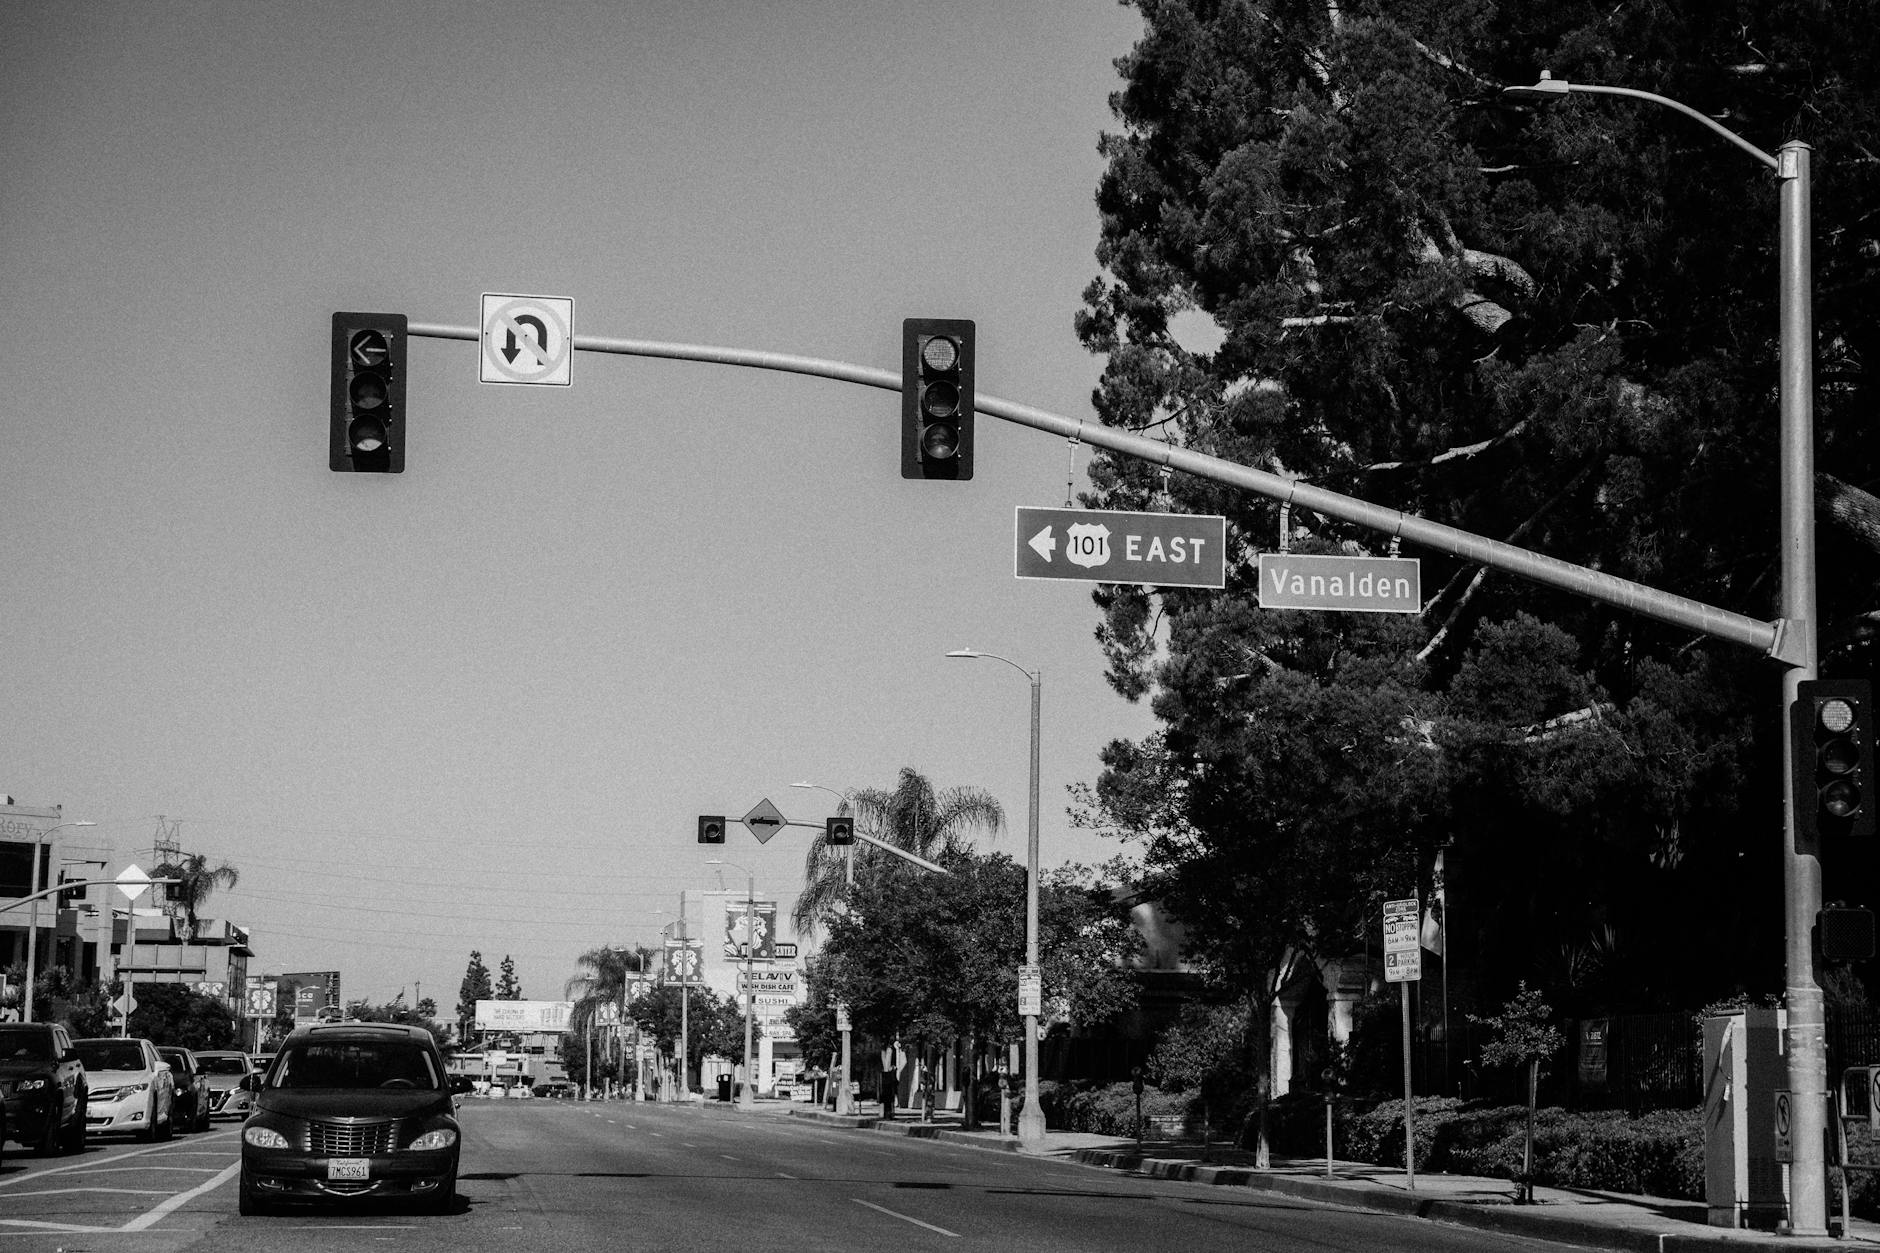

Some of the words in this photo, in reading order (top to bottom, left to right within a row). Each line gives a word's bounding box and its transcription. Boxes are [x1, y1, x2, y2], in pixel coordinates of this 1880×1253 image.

[1073, 535, 1105, 556] 101
[1125, 534, 1205, 565] EAST
[1270, 568, 1411, 599] Vanalden
[1385, 923, 1396, 934] NO
[1396, 922, 1417, 931] STOPPING
[1389, 955, 1395, 966] 2
[1397, 957, 1418, 967] PARKING
[332, 1166, 366, 1177] 7MCS961
